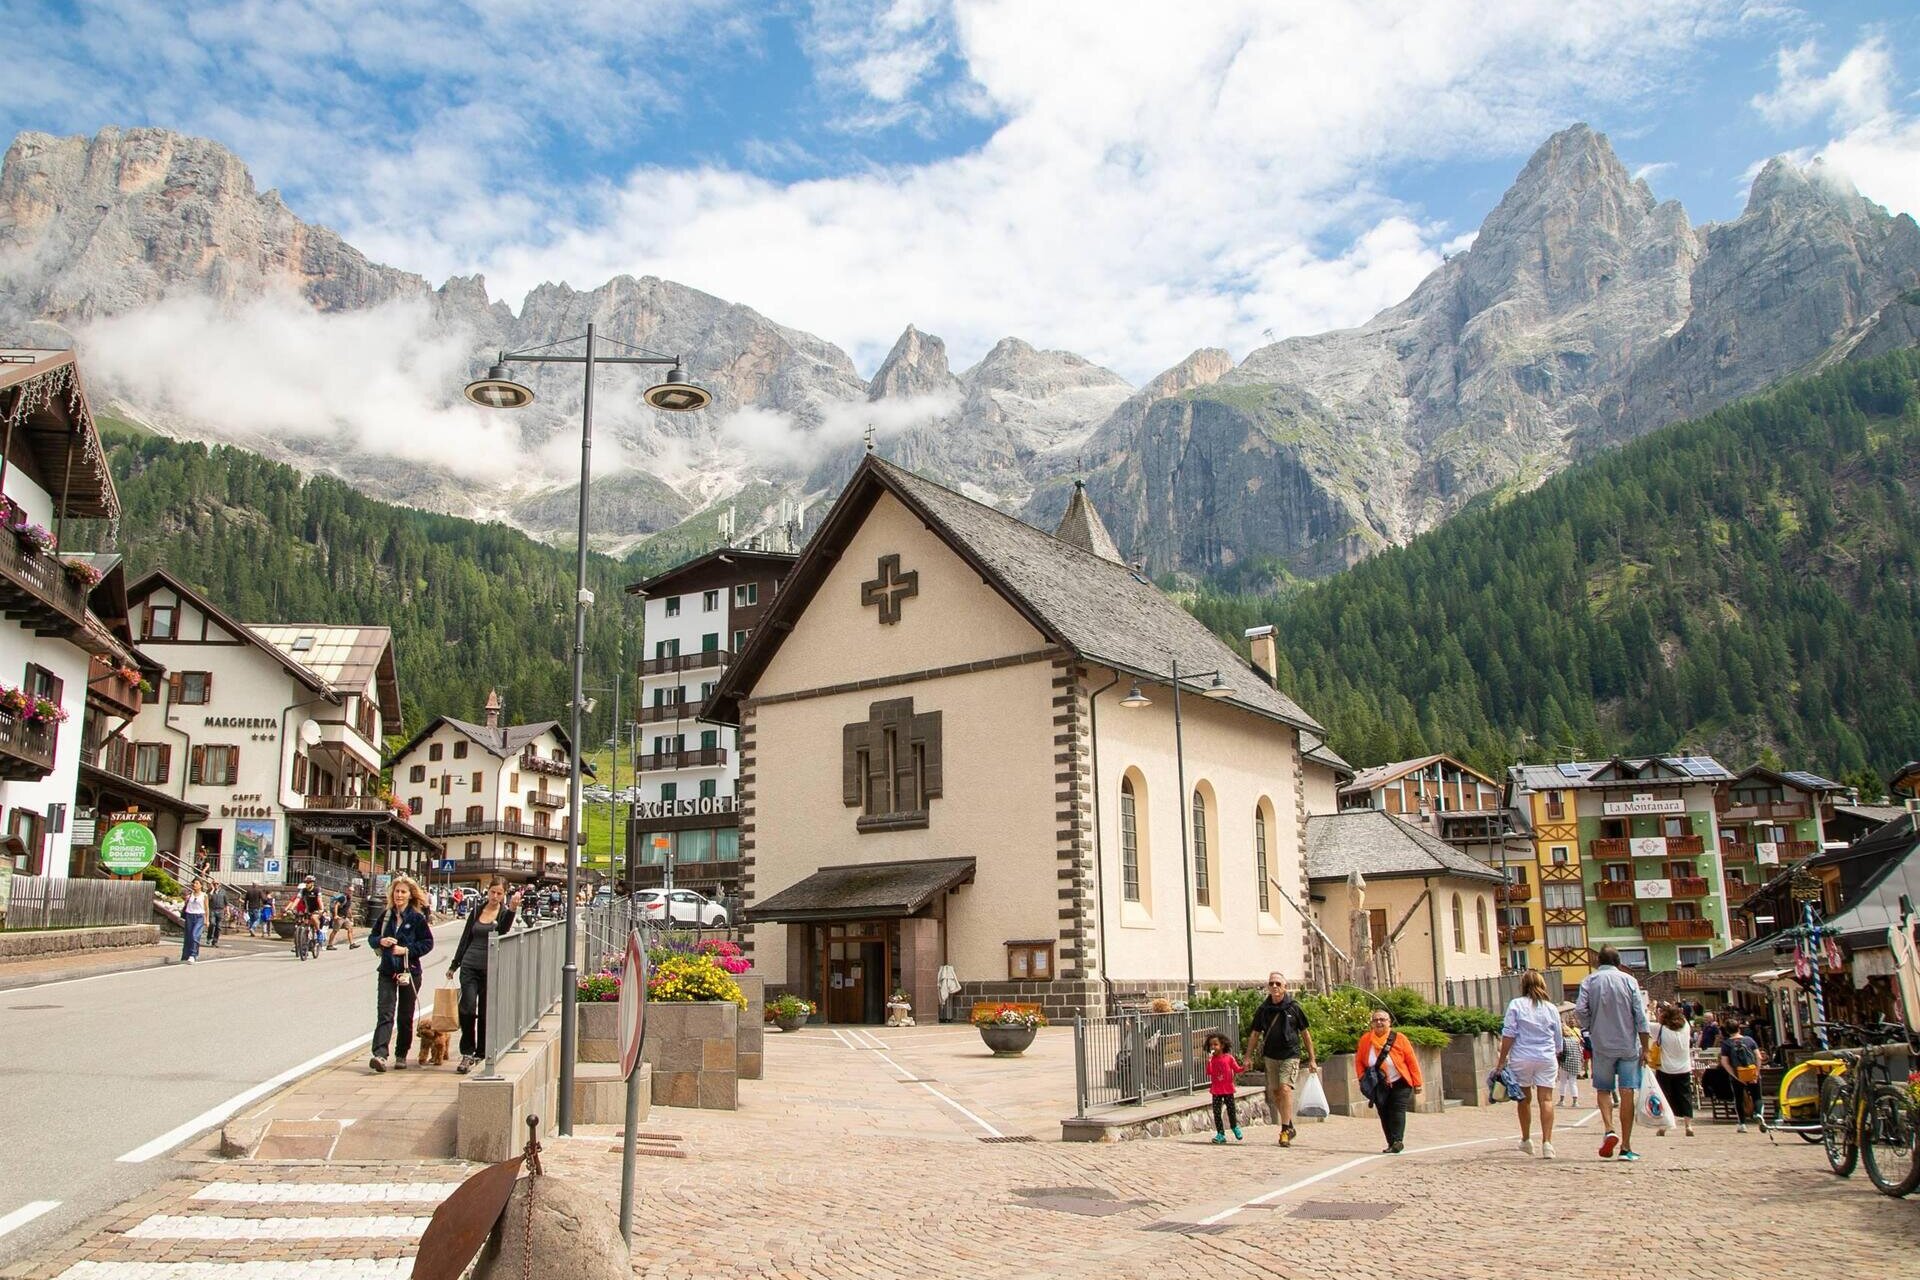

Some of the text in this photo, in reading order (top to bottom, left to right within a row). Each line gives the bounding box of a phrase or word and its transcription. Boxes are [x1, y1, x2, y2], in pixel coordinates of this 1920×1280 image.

[204, 716, 278, 729] MARGHERITA
[635, 796, 723, 819] EXCELSIOR
[1609, 802, 1680, 813] La Montanara
[110, 813, 152, 821] START 26K
